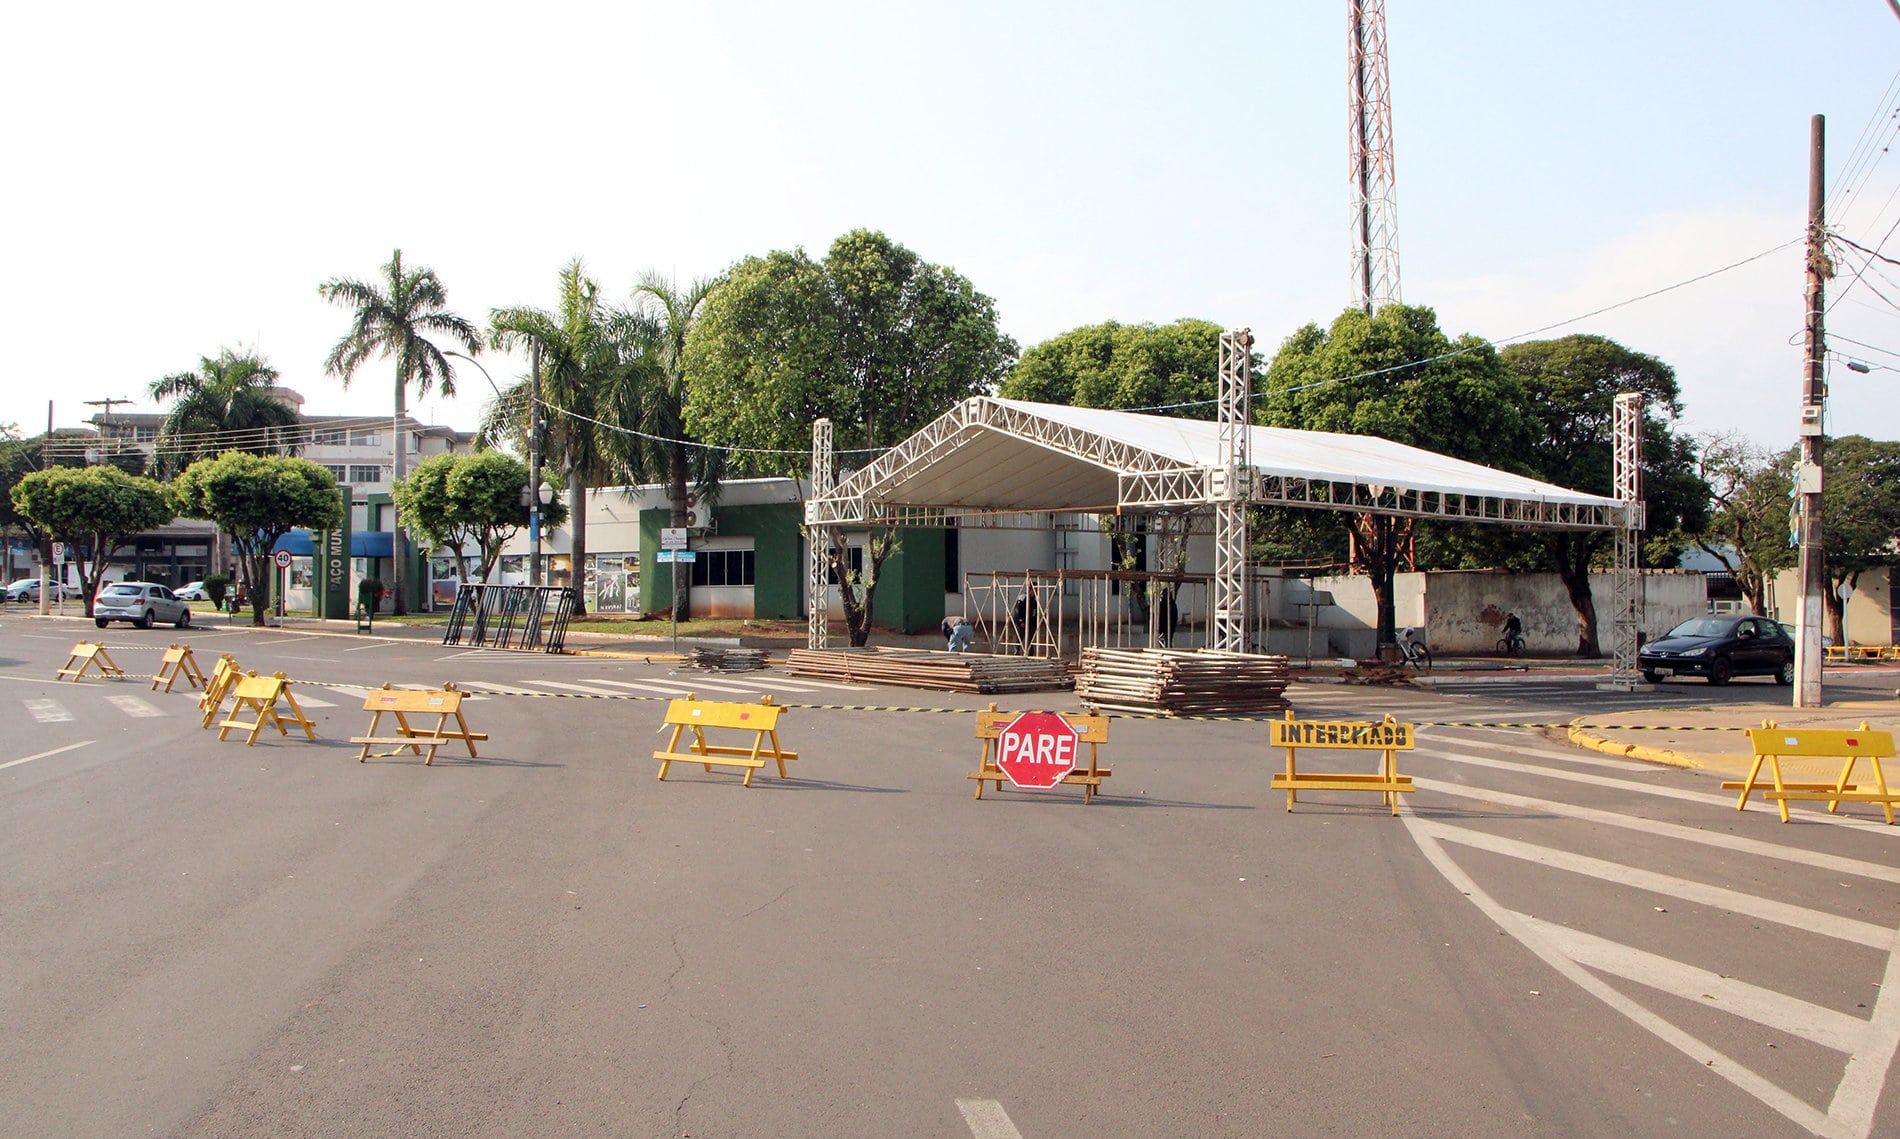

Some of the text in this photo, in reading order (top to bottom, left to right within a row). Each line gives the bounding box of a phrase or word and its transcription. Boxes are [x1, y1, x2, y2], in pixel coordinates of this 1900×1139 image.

[278, 554, 288, 562] 40
[331, 559, 344, 591] PAÇO
[1002, 732, 1073, 765] PARE
[1281, 724, 1406, 746] INTERDITADO
